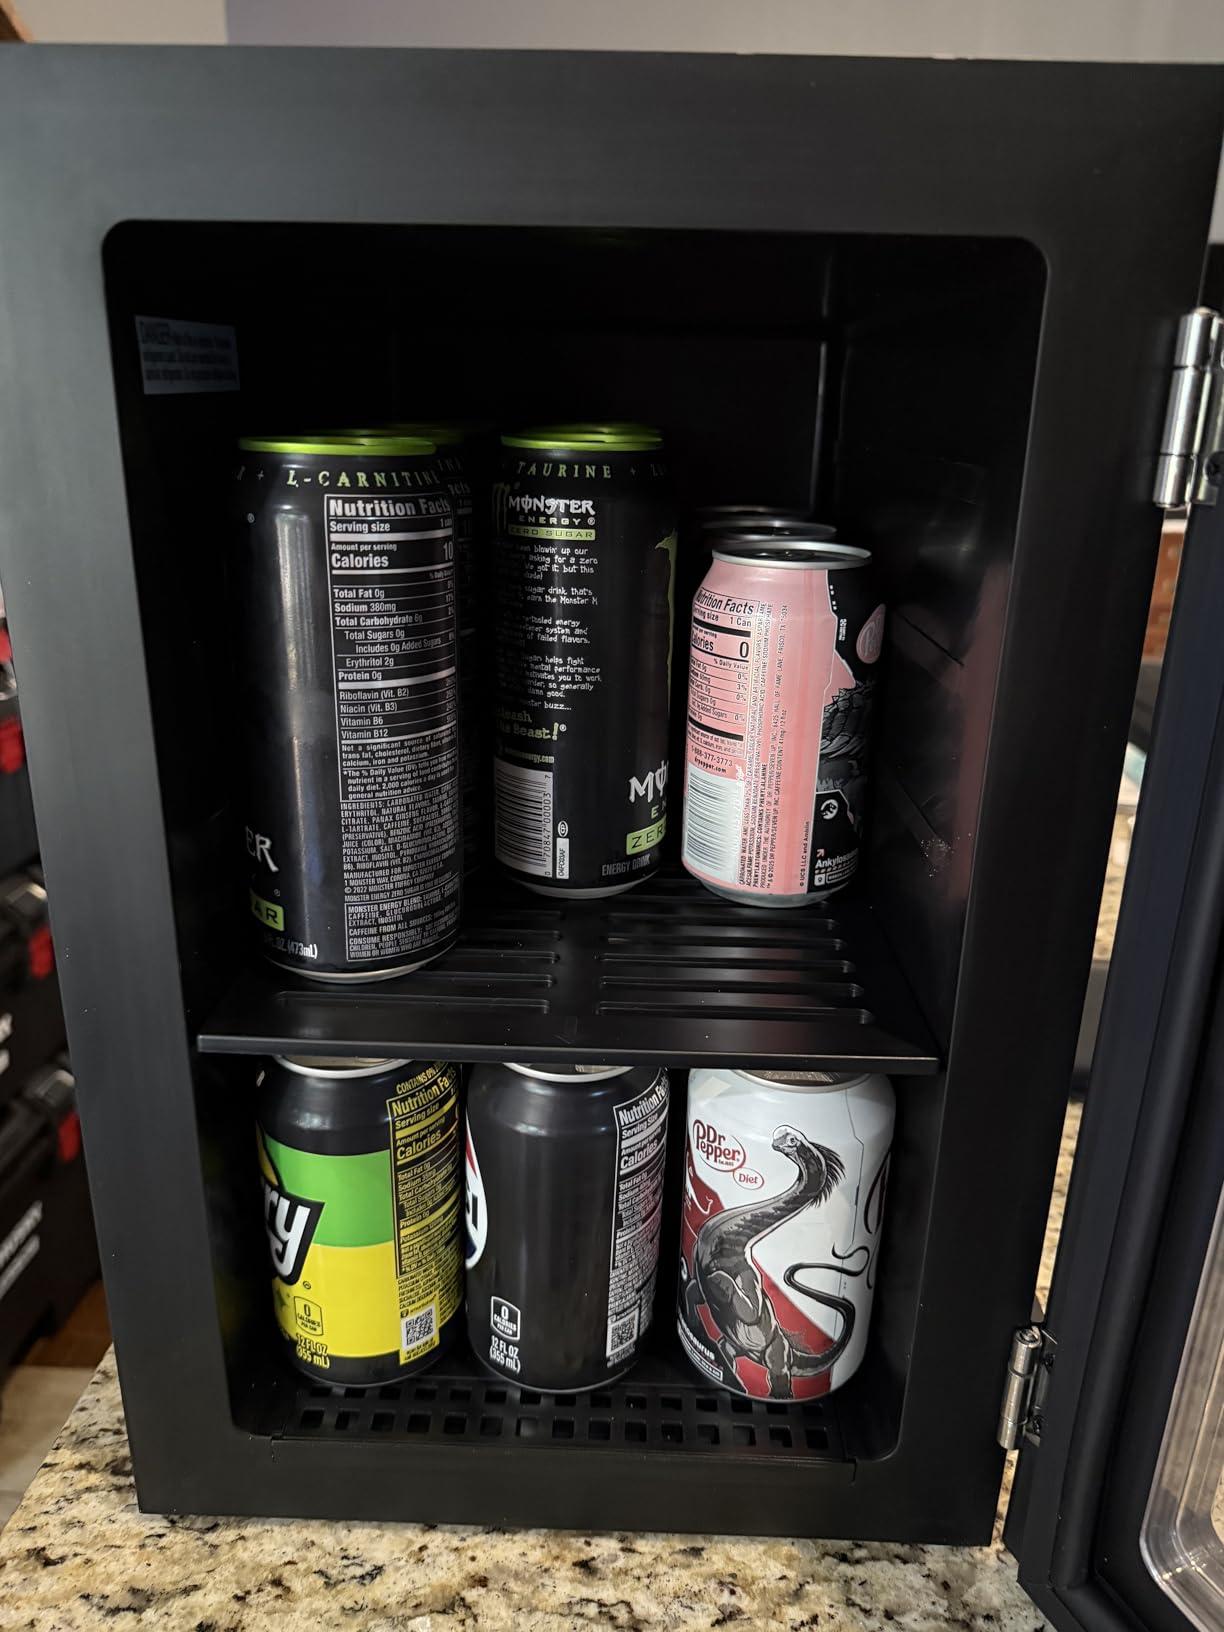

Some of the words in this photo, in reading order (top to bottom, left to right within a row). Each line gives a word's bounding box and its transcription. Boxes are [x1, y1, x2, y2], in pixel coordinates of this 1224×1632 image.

[516, 462, 612, 480] TAURINE
[329, 500, 416, 516] Nutrition
[508, 494, 596, 516] MONSTER
[518, 514, 582, 526] ENERGY
[330, 520, 368, 534] Serving
[371, 521, 391, 532] size
[509, 526, 539, 536] ZERO
[545, 528, 594, 538] SUGAR
[331, 543, 358, 552] Amount
[360, 544, 371, 554] per
[561, 548, 572, 556] up
[331, 553, 390, 568] Calories
[554, 556, 567, 564] for
[579, 558, 598, 566] zero
[562, 565, 579, 574] but
[580, 566, 595, 574] this
[334, 589, 356, 599] Total
[358, 588, 372, 599] Fat
[374, 588, 385, 600] 0g
[560, 596, 590, 606] Monster
[724, 598, 754, 615] Facts
[334, 602, 368, 613] Sodium
[370, 602, 396, 614] 380mg
[335, 616, 358, 626] Total
[360, 614, 413, 627] Carbohydrate
[555, 618, 581, 628] energy
[736, 617, 752, 628] Can
[344, 630, 366, 640] Total
[367, 630, 394, 642] Sugars
[395, 630, 405, 640] 0g
[545, 627, 571, 636] system
[574, 628, 589, 636] and
[356, 644, 388, 654] Includes
[390, 643, 400, 654] 0g
[401, 640, 422, 650] Added
[740, 641, 750, 658] 0
[346, 658, 383, 669] Erythritol
[384, 657, 394, 668] 2g
[545, 656, 564, 666] helps
[566, 656, 585, 666] fight
[554, 664, 602, 675] performance
[338, 672, 370, 681] Protein
[372, 671, 382, 682] 0g
[558, 674, 572, 682] you
[339, 690, 379, 700] Riboflavin
[380, 689, 396, 700] (Vit.
[398, 688, 410, 698] B2)
[560, 683, 595, 693] generally
[340, 704, 366, 714] Niacin
[368, 703, 384, 714] (Vit.
[385, 702, 398, 712] B3)
[340, 716, 371, 727] Vitamin
[372, 716, 384, 726] B6
[341, 730, 372, 739] Vitamin
[374, 728, 389, 738] B12
[370, 768, 386, 778] Daily
[758, 763, 768, 808] PHENYLALANINE
[774, 771, 782, 796] CAFFEINE
[340, 800, 386, 810] INGREDIENTS:
[756, 808, 764, 834] CONTAINS
[764, 808, 772, 834] AUTHORITY
[770, 816, 779, 852] PEPPER/SEVEN
[602, 860, 631, 876] ENERGY
[632, 853, 652, 871] DRINK
[352, 886, 367, 894] 2022
[348, 903, 379, 914] MONSTER
[350, 926, 379, 938] CAFFEINE
[380, 923, 397, 934] FROM
[350, 934, 382, 946] CONSUME
[395, 1072, 427, 1096] CONTAINS
[392, 1084, 441, 1118] Nutrition
[395, 1110, 426, 1130] Serving
[426, 1102, 440, 1118] size
[618, 1093, 660, 1126] Nutrition
[622, 1120, 648, 1140] Serving
[705, 1124, 726, 1146] Dr
[396, 1132, 420, 1147] Amount
[396, 1129, 442, 1161] Calories
[692, 1118, 742, 1163] Pepper
[620, 1139, 658, 1170] Calories
[398, 1169, 414, 1181] Total
[414, 1165, 424, 1176] Fat
[738, 1172, 758, 1184] Diet
[398, 1178, 422, 1192] Sodium
[618, 1179, 632, 1192] Total
[399, 1188, 414, 1201] Total
[400, 1214, 422, 1230] Protein
[500, 1305, 509, 1321] 0
[316, 1342, 328, 1356] OZ
[492, 1334, 499, 1350] 12
[500, 1339, 508, 1356] FL
[508, 1344, 520, 1360] OZ
[490, 1344, 506, 1366] (355
[505, 1356, 522, 1374] mL)
